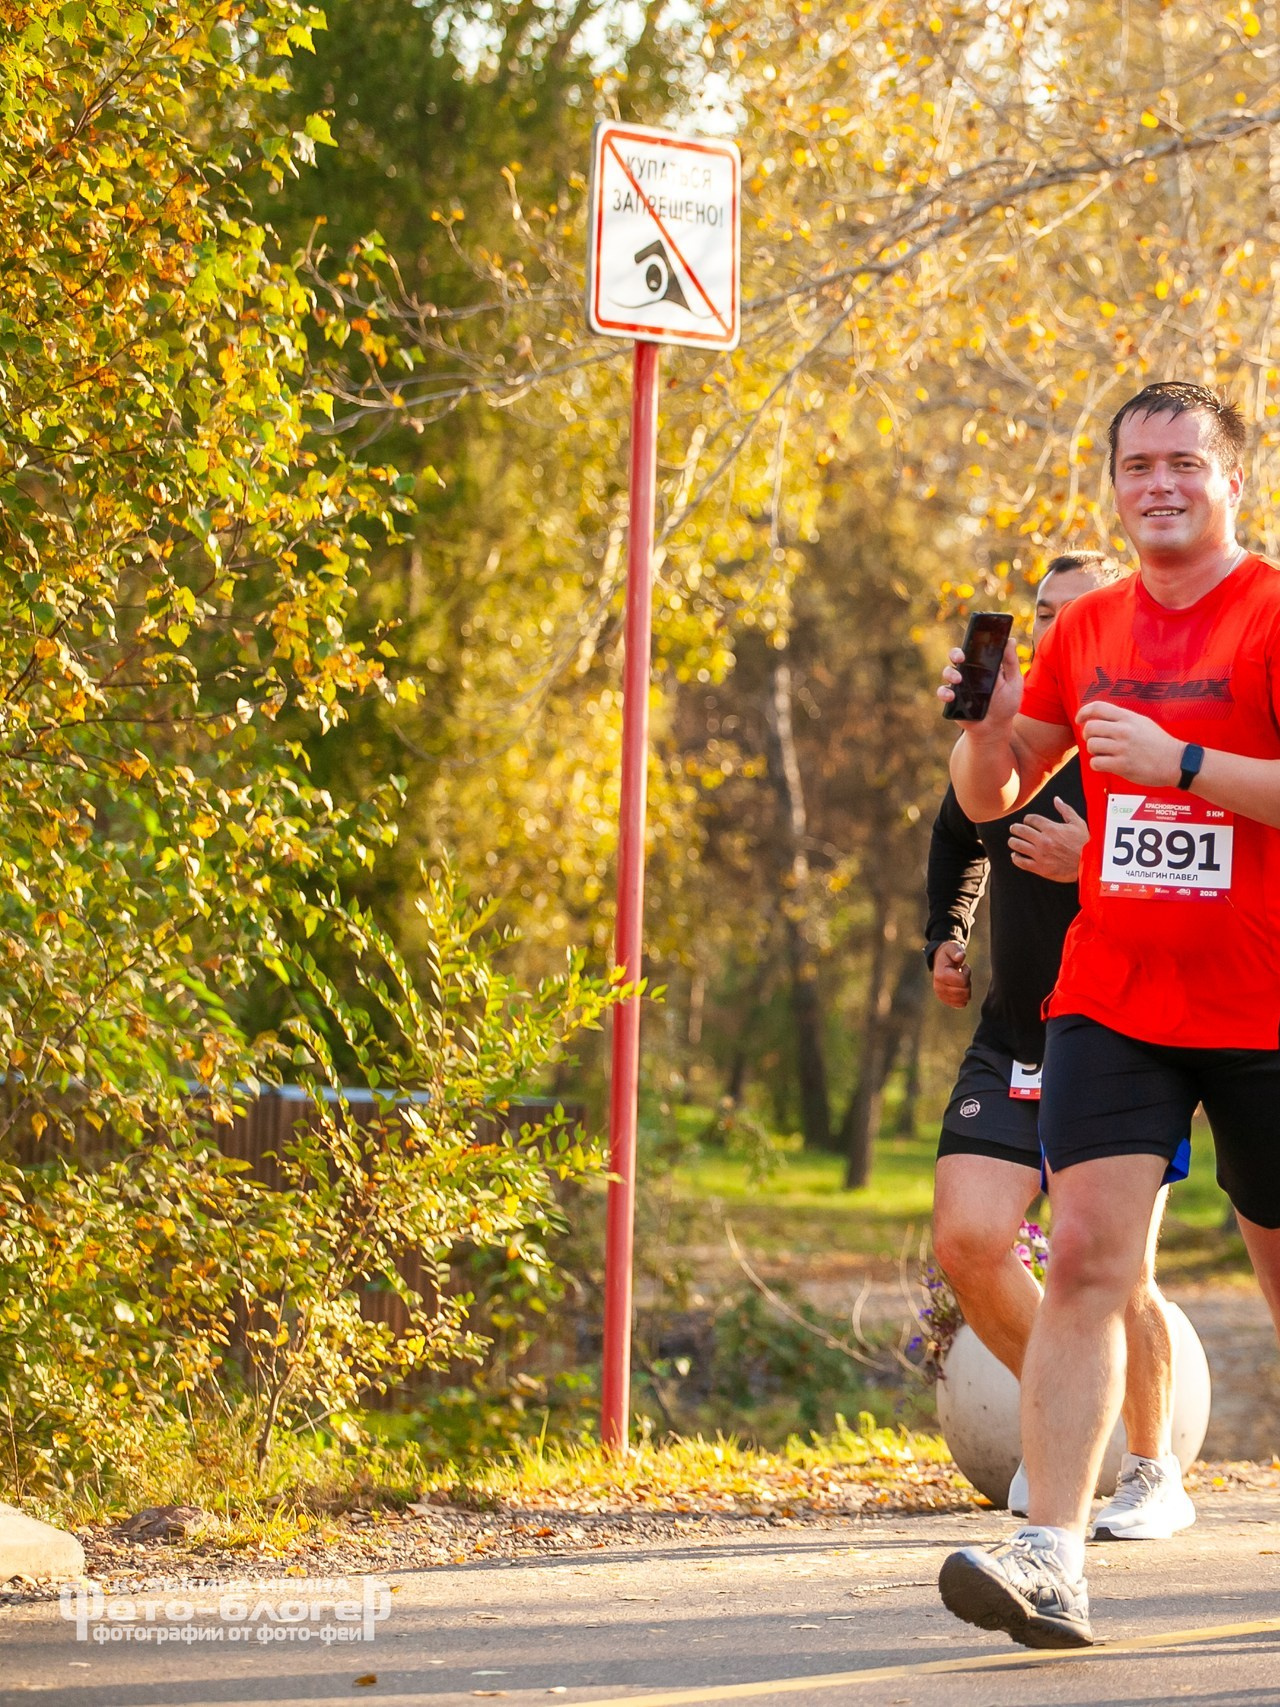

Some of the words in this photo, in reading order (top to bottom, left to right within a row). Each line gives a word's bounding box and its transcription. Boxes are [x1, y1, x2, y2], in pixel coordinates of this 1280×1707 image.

[626, 155, 712, 189] КУПАТЬСЯ
[613, 188, 724, 228] ЗАПРЕЩЕНО!
[1145, 803, 1191, 812] КРАСНОЯРСКИЕ
[1112, 826, 1221, 872] 5891
[1125, 870, 1168, 880] ЧАПЛЫГИН
[1169, 872, 1199, 881] ПАВЕЛ
